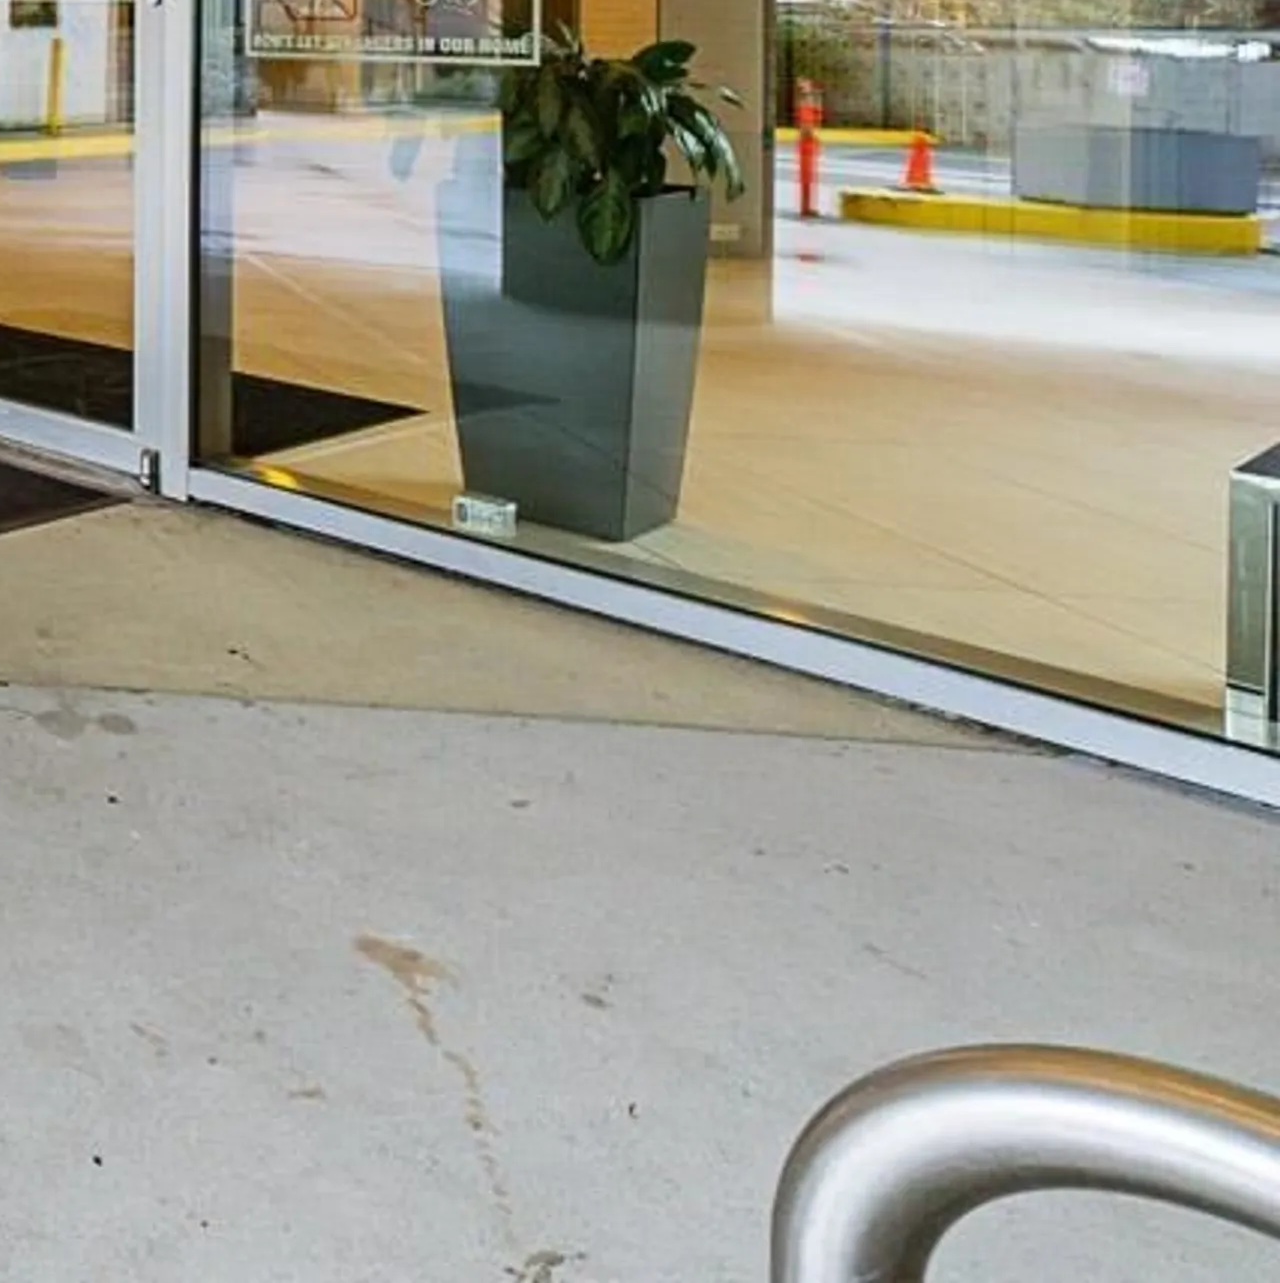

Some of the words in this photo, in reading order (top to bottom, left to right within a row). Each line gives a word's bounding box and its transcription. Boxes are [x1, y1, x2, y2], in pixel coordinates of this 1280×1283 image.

[417, 37, 436, 52] IN
[440, 37, 474, 53] OUR
[478, 37, 532, 55] HOME
